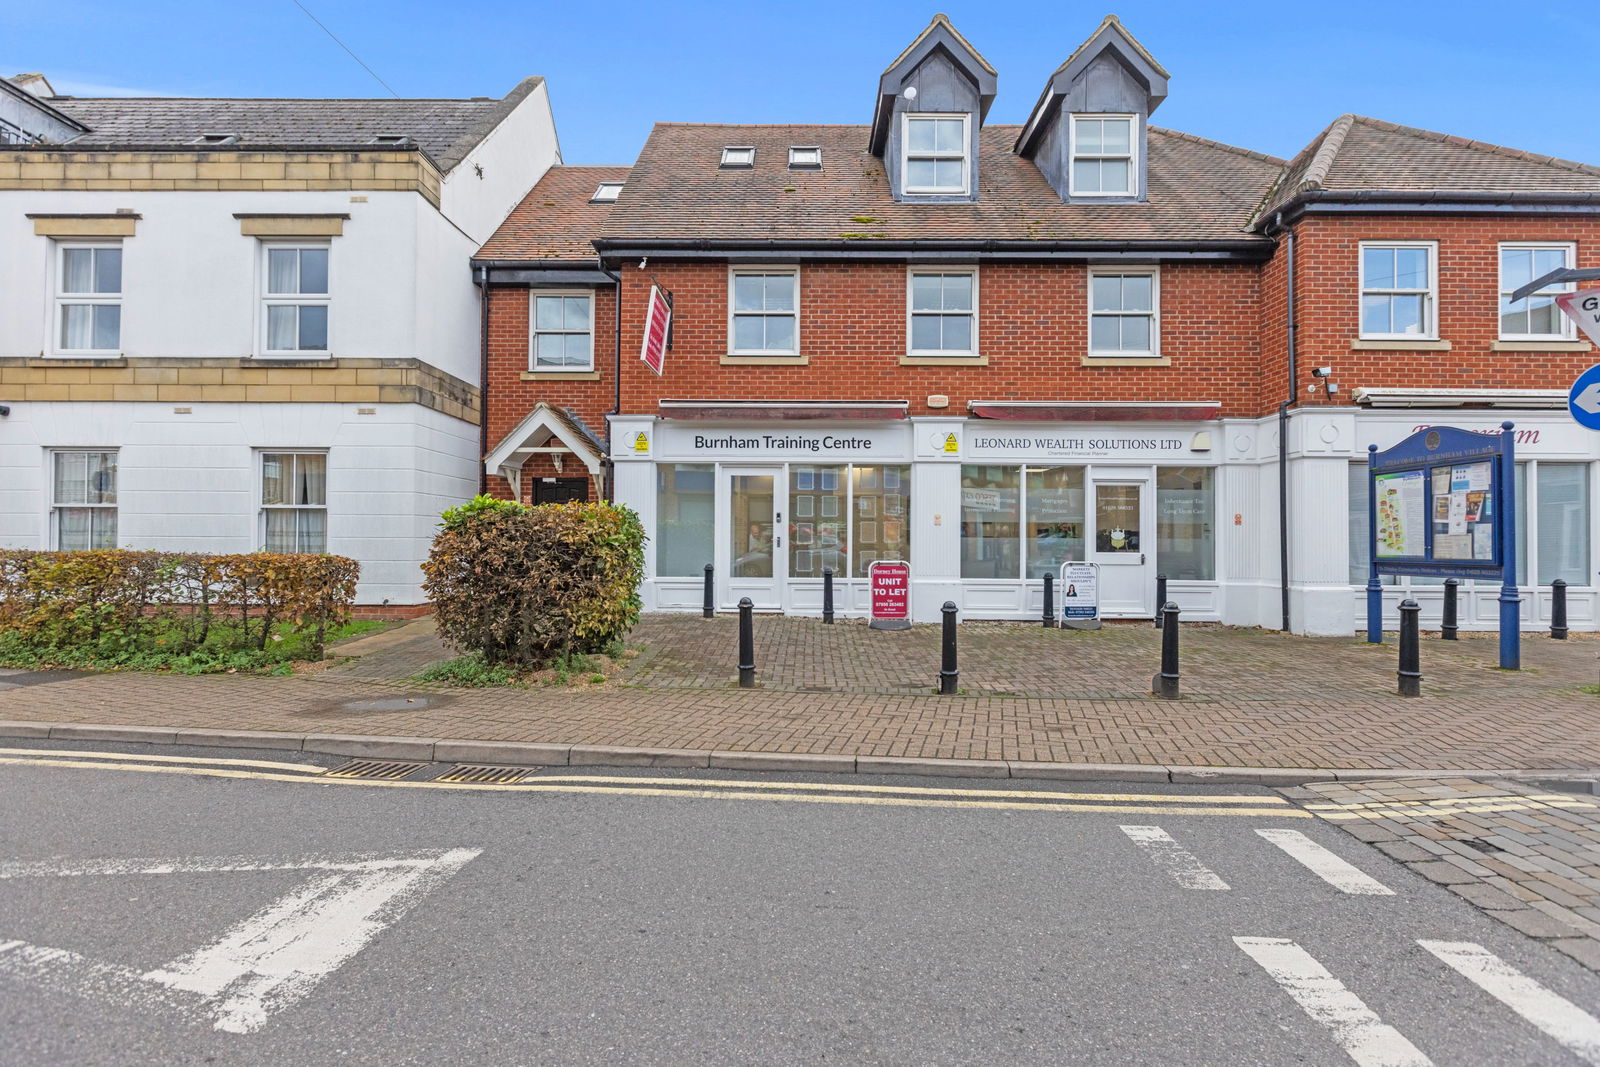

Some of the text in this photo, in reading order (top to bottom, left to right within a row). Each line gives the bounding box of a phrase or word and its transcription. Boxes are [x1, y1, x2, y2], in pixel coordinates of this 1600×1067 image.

[694, 435, 872, 451] Burnham Training Centre
[975, 438, 1183, 450] LEONARD WEALTH SOLUTIONS LTD
[1427, 450, 1462, 461] BURNHAM
[1464, 446, 1495, 457] VILLAGE
